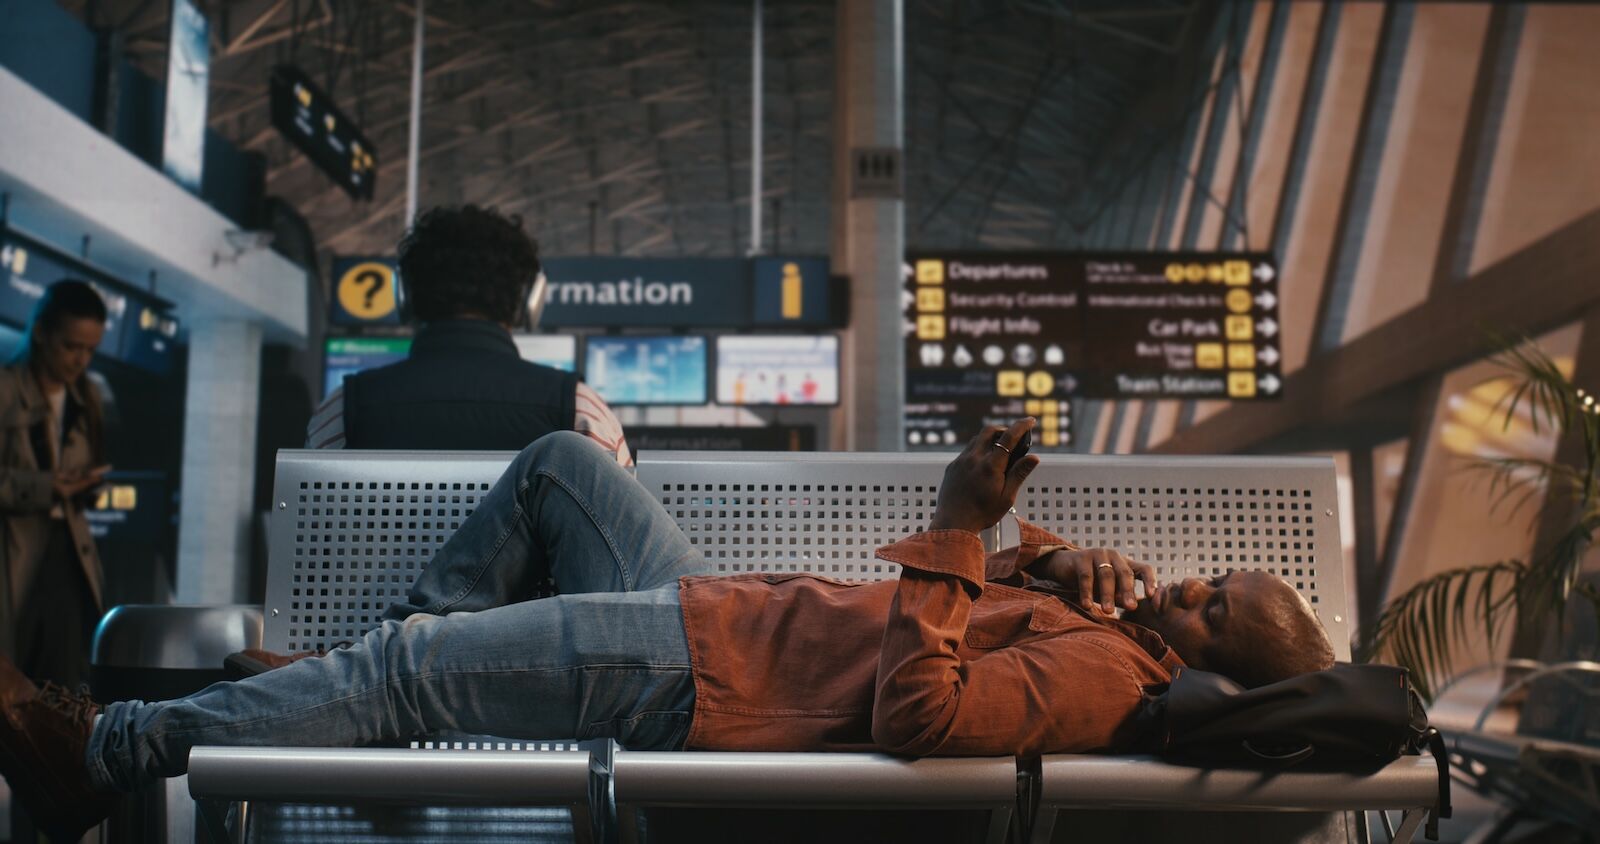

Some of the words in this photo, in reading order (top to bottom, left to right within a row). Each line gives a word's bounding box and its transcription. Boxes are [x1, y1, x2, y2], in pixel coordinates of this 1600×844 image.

[949, 262, 1048, 280] Departures
[544, 277, 692, 304] rmation
[951, 293, 1013, 308] Security
[1017, 293, 1077, 307] Control
[951, 317, 1001, 337] Flight
[1004, 317, 1041, 334] Info
[1148, 319, 1179, 336] Car
[1181, 319, 1220, 336] Park
[1136, 342, 1162, 355] Bus
[1117, 375, 1159, 391] Train
[1161, 375, 1224, 392] Station
[626, 434, 742, 449] nformation
